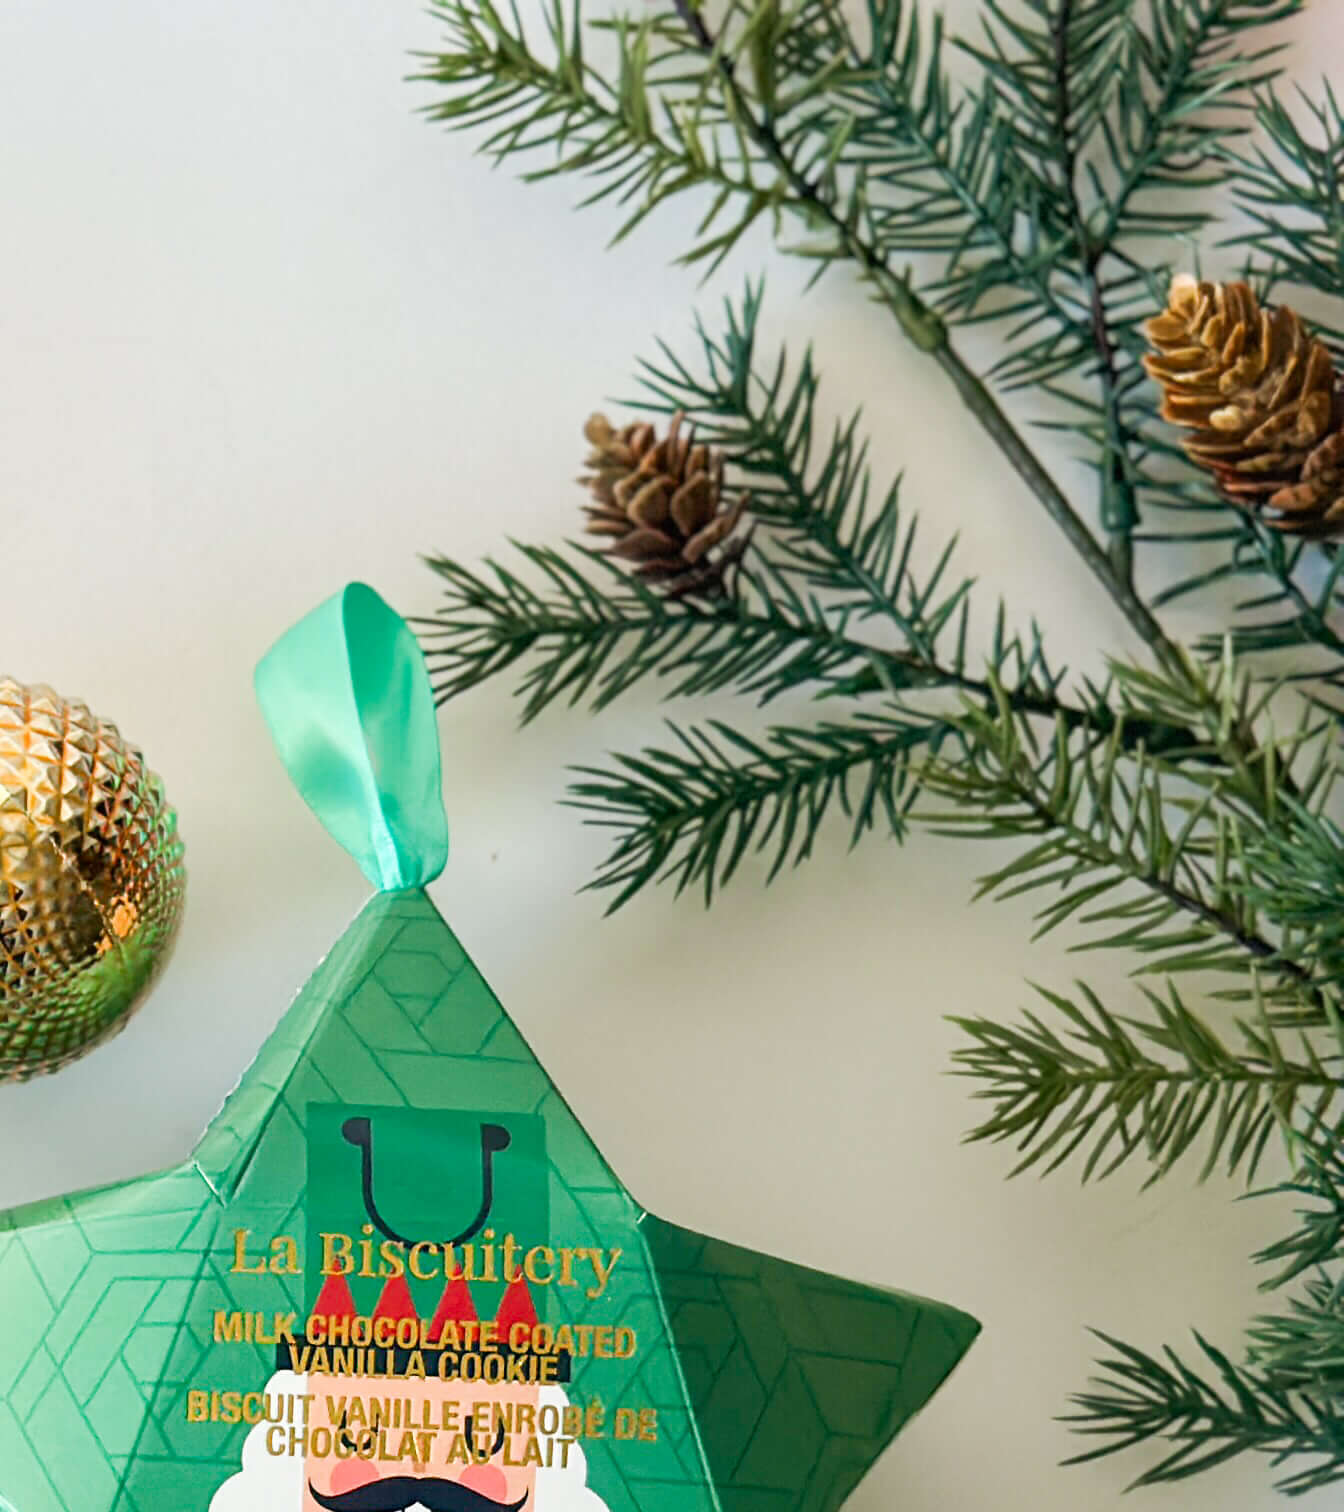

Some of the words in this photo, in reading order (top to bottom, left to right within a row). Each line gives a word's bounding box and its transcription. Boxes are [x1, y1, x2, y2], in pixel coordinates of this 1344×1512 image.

[230, 1227, 301, 1275] La
[319, 1224, 622, 1300] Biscuitery
[214, 1311, 299, 1346] MILK
[306, 1313, 500, 1354] CHOCOLATE
[509, 1321, 635, 1359] COATED
[290, 1343, 427, 1381] VANILLA
[437, 1349, 561, 1386] COOKIE
[187, 1389, 316, 1425] BISCUIT
[325, 1395, 460, 1432] VANILLE
[472, 1400, 607, 1439] ENROBÉ
[614, 1406, 657, 1442] DE
[265, 1425, 437, 1464] CHOCOLAT
[447, 1431, 495, 1466] AU
[503, 1434, 576, 1469] LAIT
